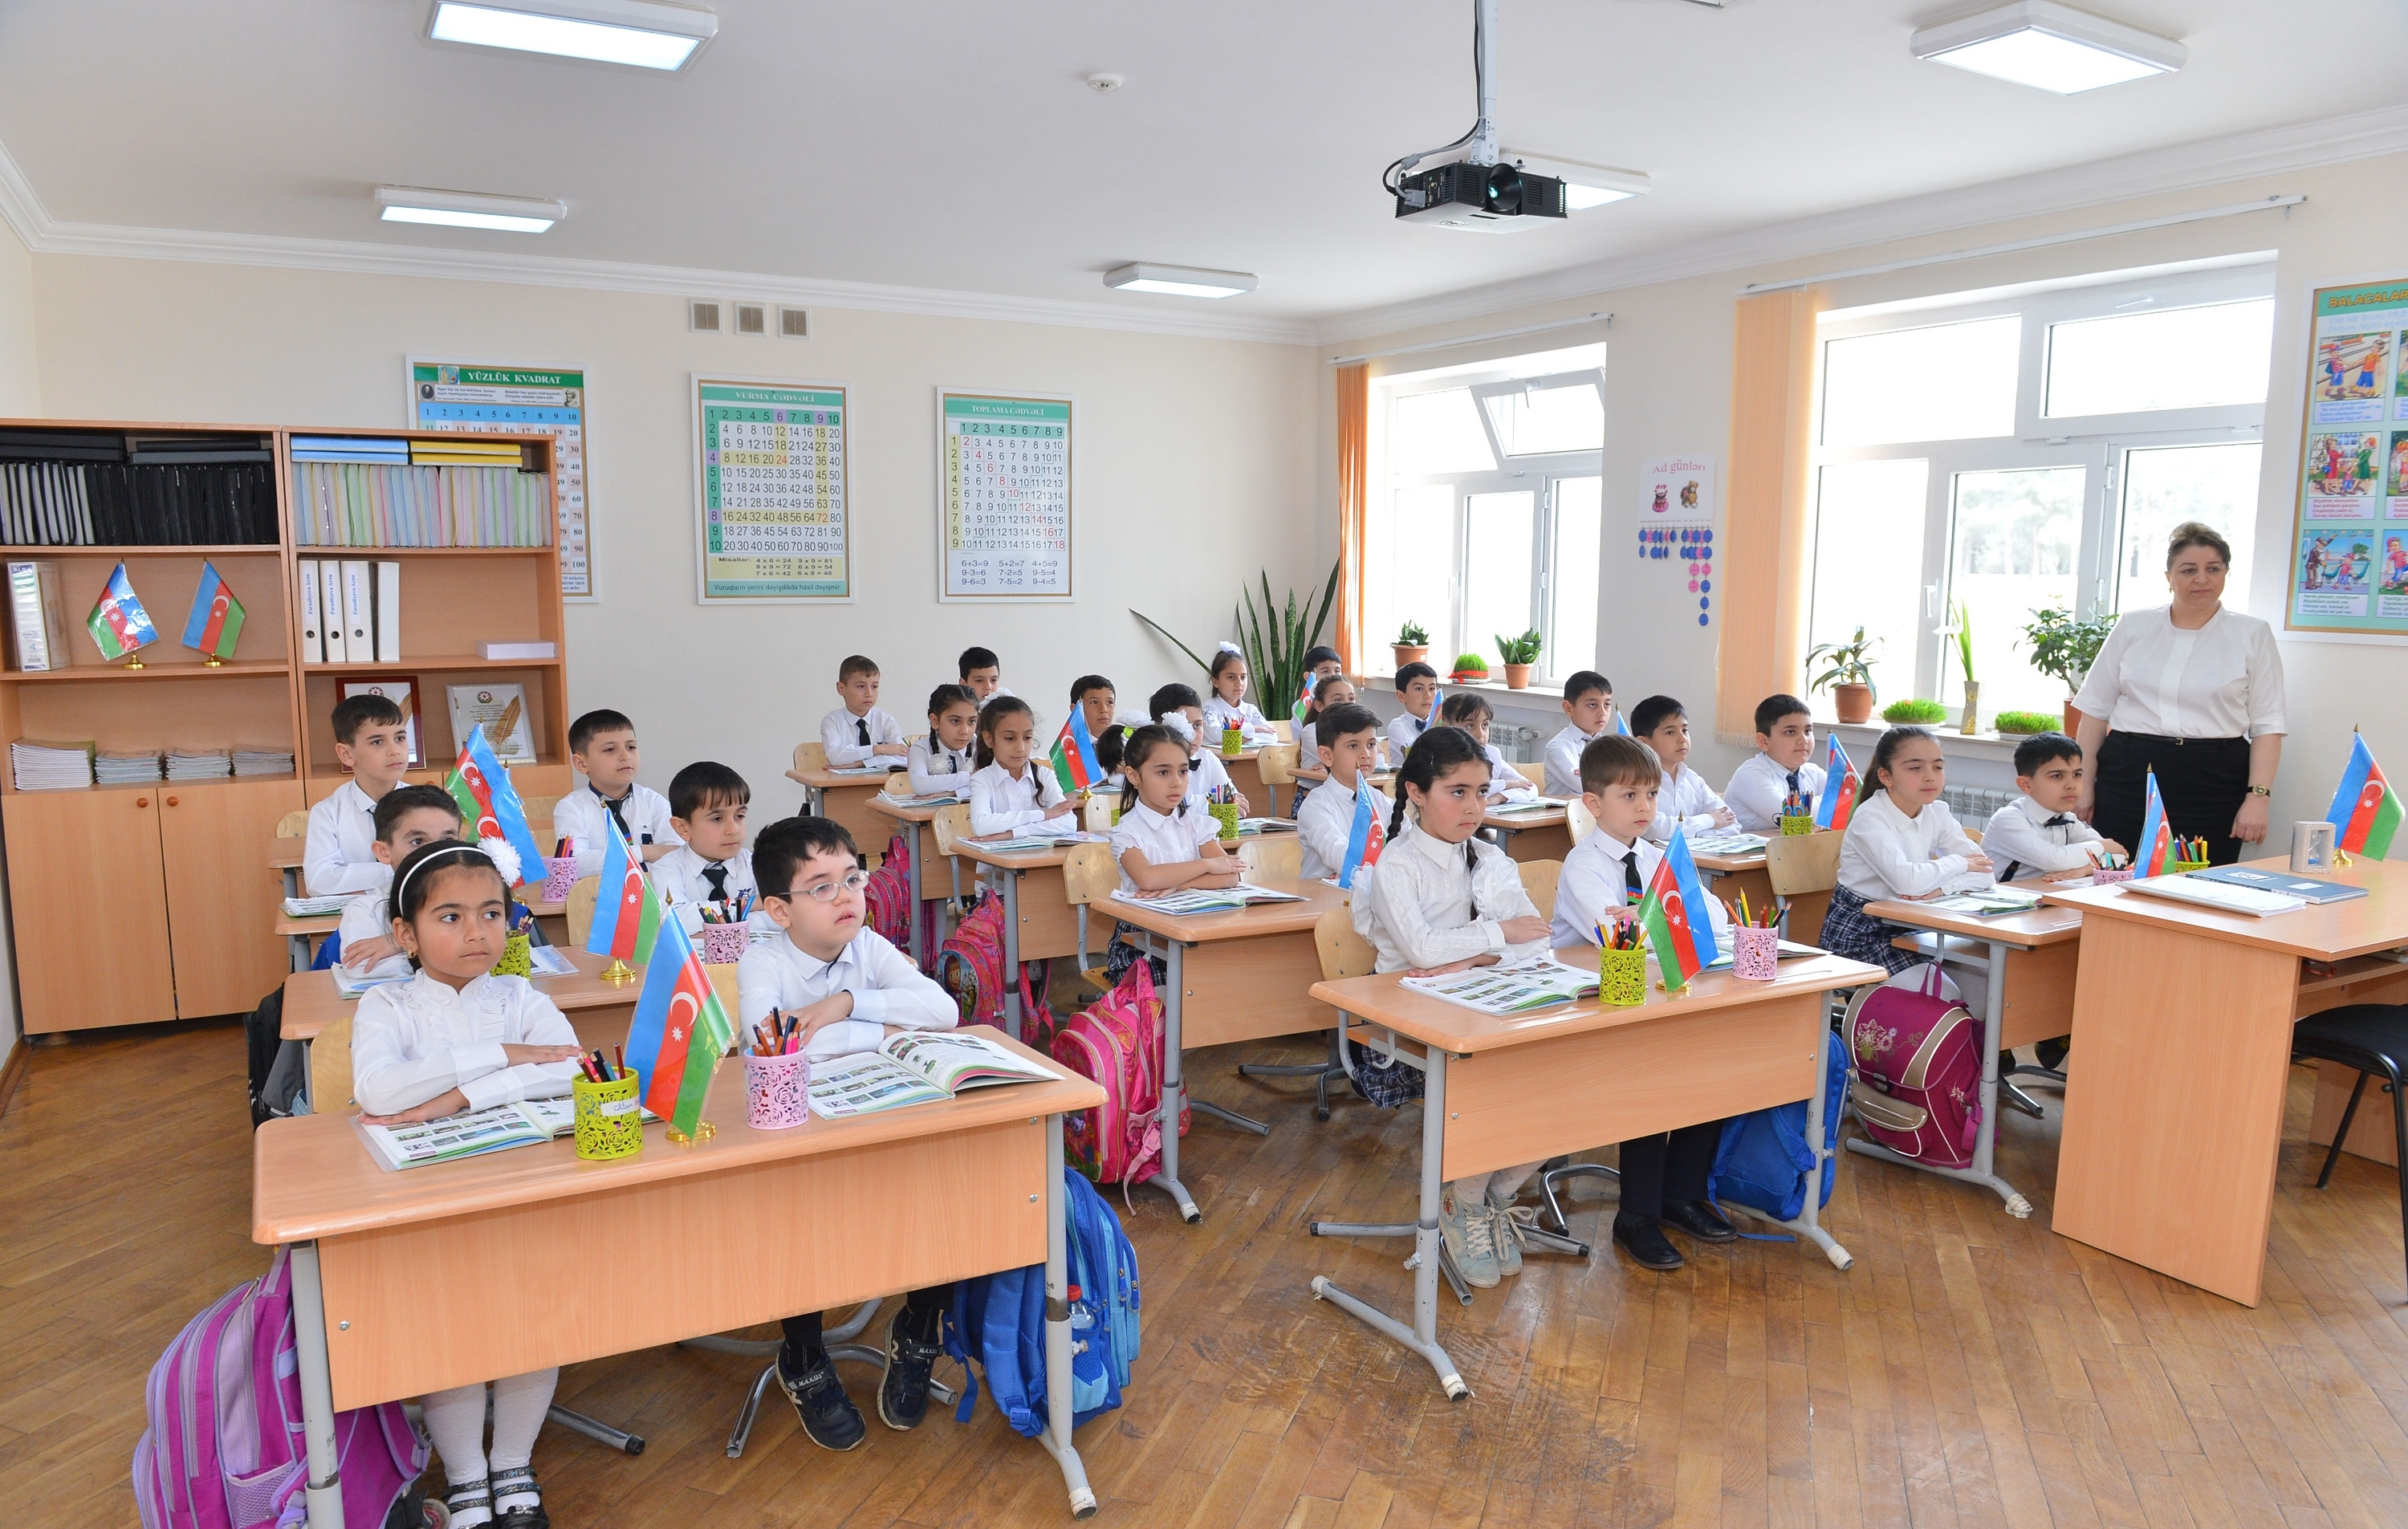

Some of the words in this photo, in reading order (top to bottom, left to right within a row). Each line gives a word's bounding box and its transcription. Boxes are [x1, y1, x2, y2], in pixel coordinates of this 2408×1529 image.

[2329, 289, 2408, 308] BALACALAR
[468, 371, 510, 382] YÜZLÜK
[515, 374, 561, 384] KVADRAT
[735, 392, 769, 400] VURMA
[972, 405, 1009, 414] TOPLAMA
[710, 410, 714, 418] 1
[722, 410, 728, 419] 2
[736, 411, 742, 420] 3
[750, 412, 755, 420] 4
[763, 412, 770, 421] 5
[777, 412, 783, 421] 6
[791, 413, 796, 421] 7
[804, 413, 810, 423] 8
[817, 414, 823, 423] 9
[828, 415, 840, 424] 10
[710, 424, 715, 433] 2
[723, 425, 728, 433] 4
[737, 425, 742, 434] 6
[750, 425, 756, 435] 8
[763, 426, 772, 436] 10
[775, 427, 786, 437] 12
[790, 428, 799, 437] 14
[803, 428, 812, 437] 16
[816, 428, 825, 438] 18
[829, 429, 840, 438] 20
[962, 424, 966, 432] 1
[973, 423, 978, 433] 2
[985, 424, 990, 433] 3
[999, 425, 1004, 433] 4
[1011, 425, 1016, 434] 5
[1023, 426, 1027, 435] 6
[1034, 426, 1039, 435] 7
[1045, 427, 1051, 436] 8
[1057, 427, 1062, 436] 9
[710, 437, 716, 447] 3
[724, 438, 730, 448] 6
[737, 439, 743, 449] 9
[748, 439, 760, 449] 12
[763, 440, 774, 449] 15
[775, 441, 787, 450] 18
[789, 441, 799, 450] 21
[802, 441, 814, 451] 24
[816, 442, 827, 452] 27
[828, 442, 840, 452] 30
[952, 437, 956, 445] 1
[964, 437, 970, 446] 2
[974, 438, 980, 447] 3
[986, 439, 992, 447] 4
[999, 440, 1003, 448] 5
[1010, 440, 1015, 448] 6
[1022, 441, 1027, 449] 7
[1033, 441, 1039, 449] 8
[1045, 441, 1050, 449] 9
[1053, 441, 1063, 450] 10
[710, 453, 715, 462] 4
[724, 453, 730, 462] 8
[736, 453, 746, 463] 12
[749, 454, 759, 464] 16
[763, 454, 774, 464] 20
[776, 455, 787, 465] 24
[790, 455, 800, 465] 28
[803, 456, 813, 466] 32
[816, 456, 826, 466] 36
[829, 457, 840, 466] 40
[951, 449, 958, 458] 2
[964, 450, 970, 459] 3
[975, 450, 981, 459] 4
[987, 452, 993, 460] 5
[999, 452, 1004, 460] 6
[1011, 453, 1016, 461] 7
[1023, 453, 1027, 462] 8
[1034, 453, 1039, 462] 9
[1043, 453, 1051, 462] 10
[1053, 454, 1061, 462] 11
[952, 462, 958, 471] 3
[964, 463, 970, 471] 4
[976, 464, 982, 472] 5
[987, 464, 994, 473] 6
[999, 465, 1005, 473] 7
[1011, 465, 1016, 474] 8
[1023, 466, 1028, 474] 9
[1031, 466, 1041, 474] 10
[1043, 466, 1051, 474] 11
[1053, 466, 1063, 474] 12
[1653, 462, 1667, 474] Ad
[1670, 459, 1706, 474] günləri
[710, 467, 716, 477] 5
[722, 468, 732, 478] 10
[736, 468, 746, 478] 15
[750, 469, 760, 478] 20
[763, 469, 774, 478] 25
[776, 469, 787, 478] 30
[790, 470, 800, 479] 35
[803, 470, 813, 479] 40
[816, 470, 827, 480] 45
[829, 470, 840, 480] 50
